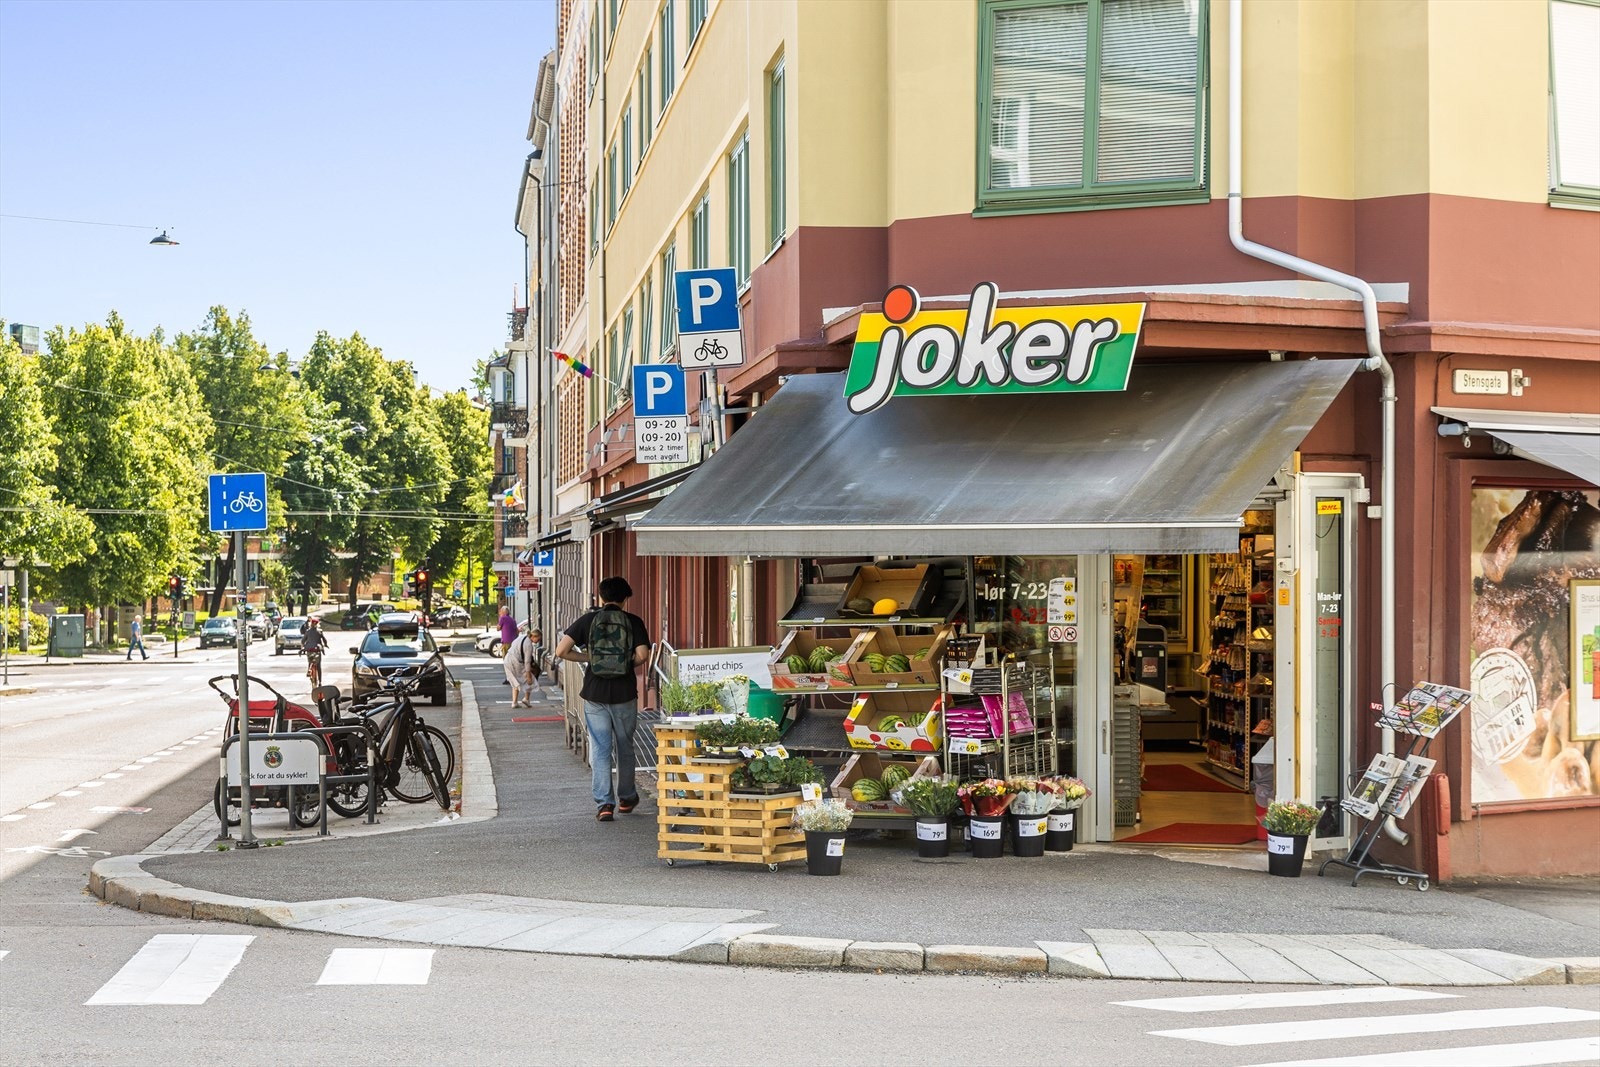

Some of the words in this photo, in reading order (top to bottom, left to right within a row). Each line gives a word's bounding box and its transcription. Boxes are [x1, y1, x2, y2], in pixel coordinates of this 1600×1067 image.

[690, 277, 723, 325] P
[847, 281, 1119, 415] joker
[1463, 373, 1502, 391] Stensgata
[645, 371, 673, 410] P
[660, 453, 680, 462] avgift
[538, 550, 549, 565] P
[1011, 582, 1048, 600] 7-23
[1011, 607, 1047, 625] 9-23
[1321, 604, 1338, 614] 7-23
[687, 661, 720, 672] Maarud
[721, 660, 744, 671] chips
[1370, 702, 1383, 711] VG
[256, 772, 267, 780] for
[286, 771, 308, 780] sykler!
